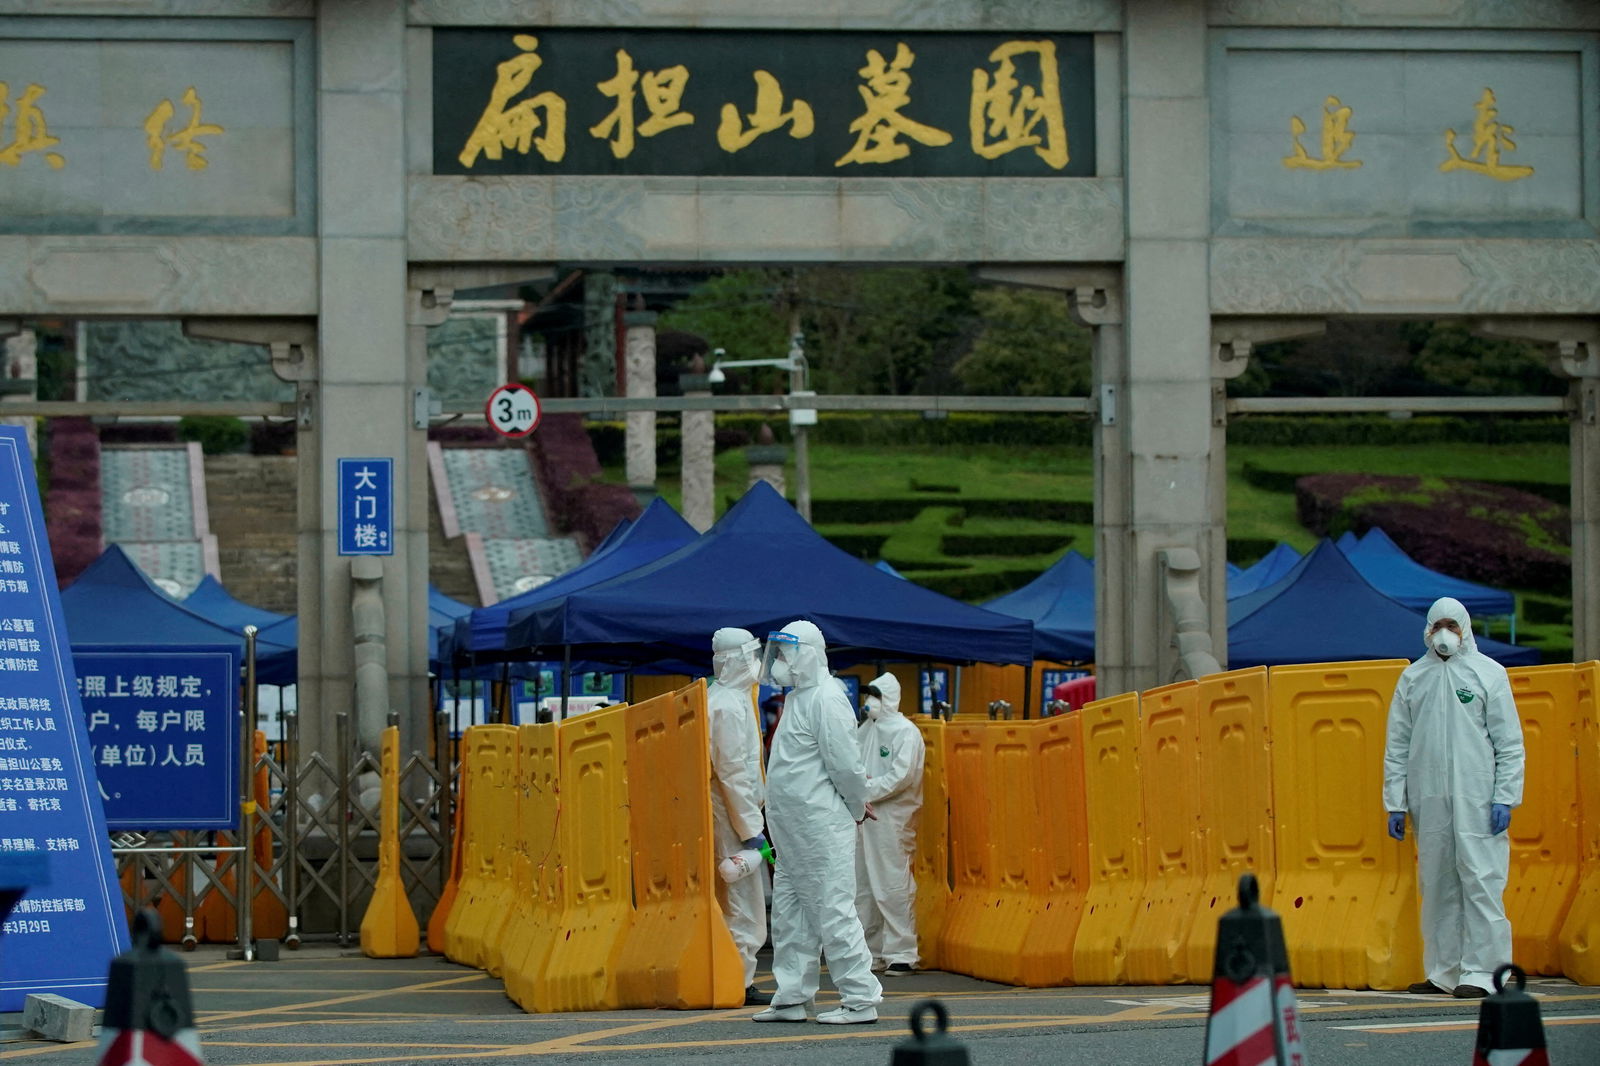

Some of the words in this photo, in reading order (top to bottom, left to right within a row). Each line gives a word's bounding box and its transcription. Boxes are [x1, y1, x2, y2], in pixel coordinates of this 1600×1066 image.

[498, 398, 532, 423] 3m
[354, 466, 377, 548] 大门楼
[0, 560, 24, 574] 情防
[0, 618, 35, 632] 公墓暂
[0, 718, 57, 731] 织工作人员
[0, 777, 68, 791] 实名登录汉阳
[0, 837, 80, 852] 界理解、支持和
